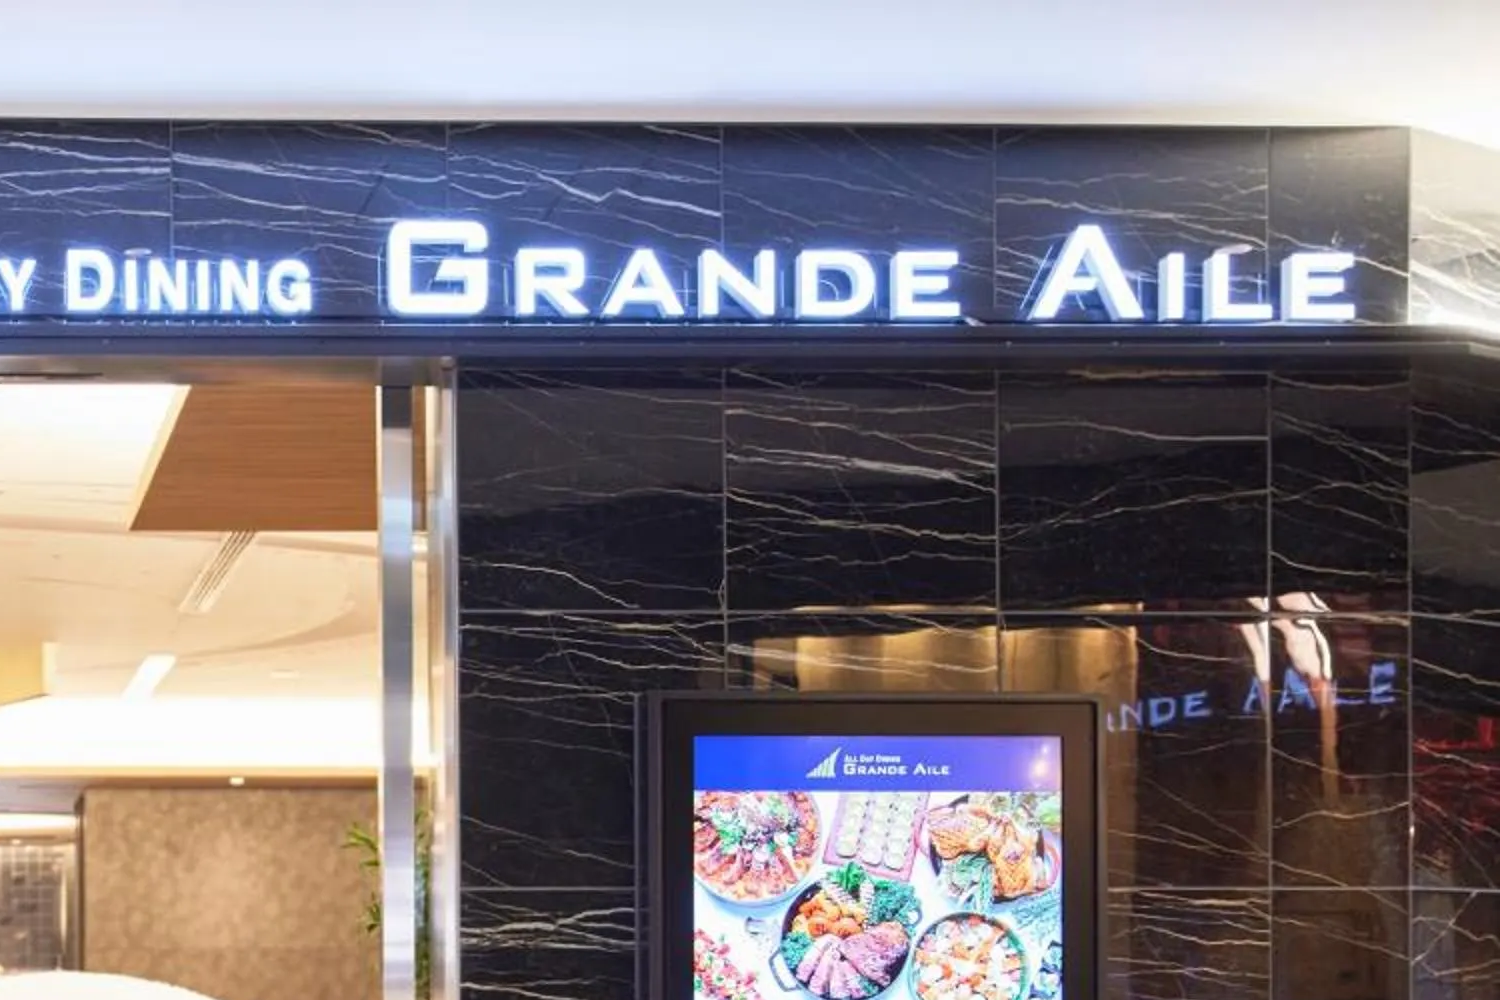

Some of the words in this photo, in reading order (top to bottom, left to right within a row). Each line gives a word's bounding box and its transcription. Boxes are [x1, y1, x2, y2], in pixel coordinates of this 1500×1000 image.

[66, 249, 314, 313] DINING
[386, 219, 960, 319] GRANDE
[1026, 224, 1356, 321] AILE
[1106, 690, 1212, 733] NDE
[843, 763, 908, 776] GRANDE
[913, 763, 949, 776] AILE
